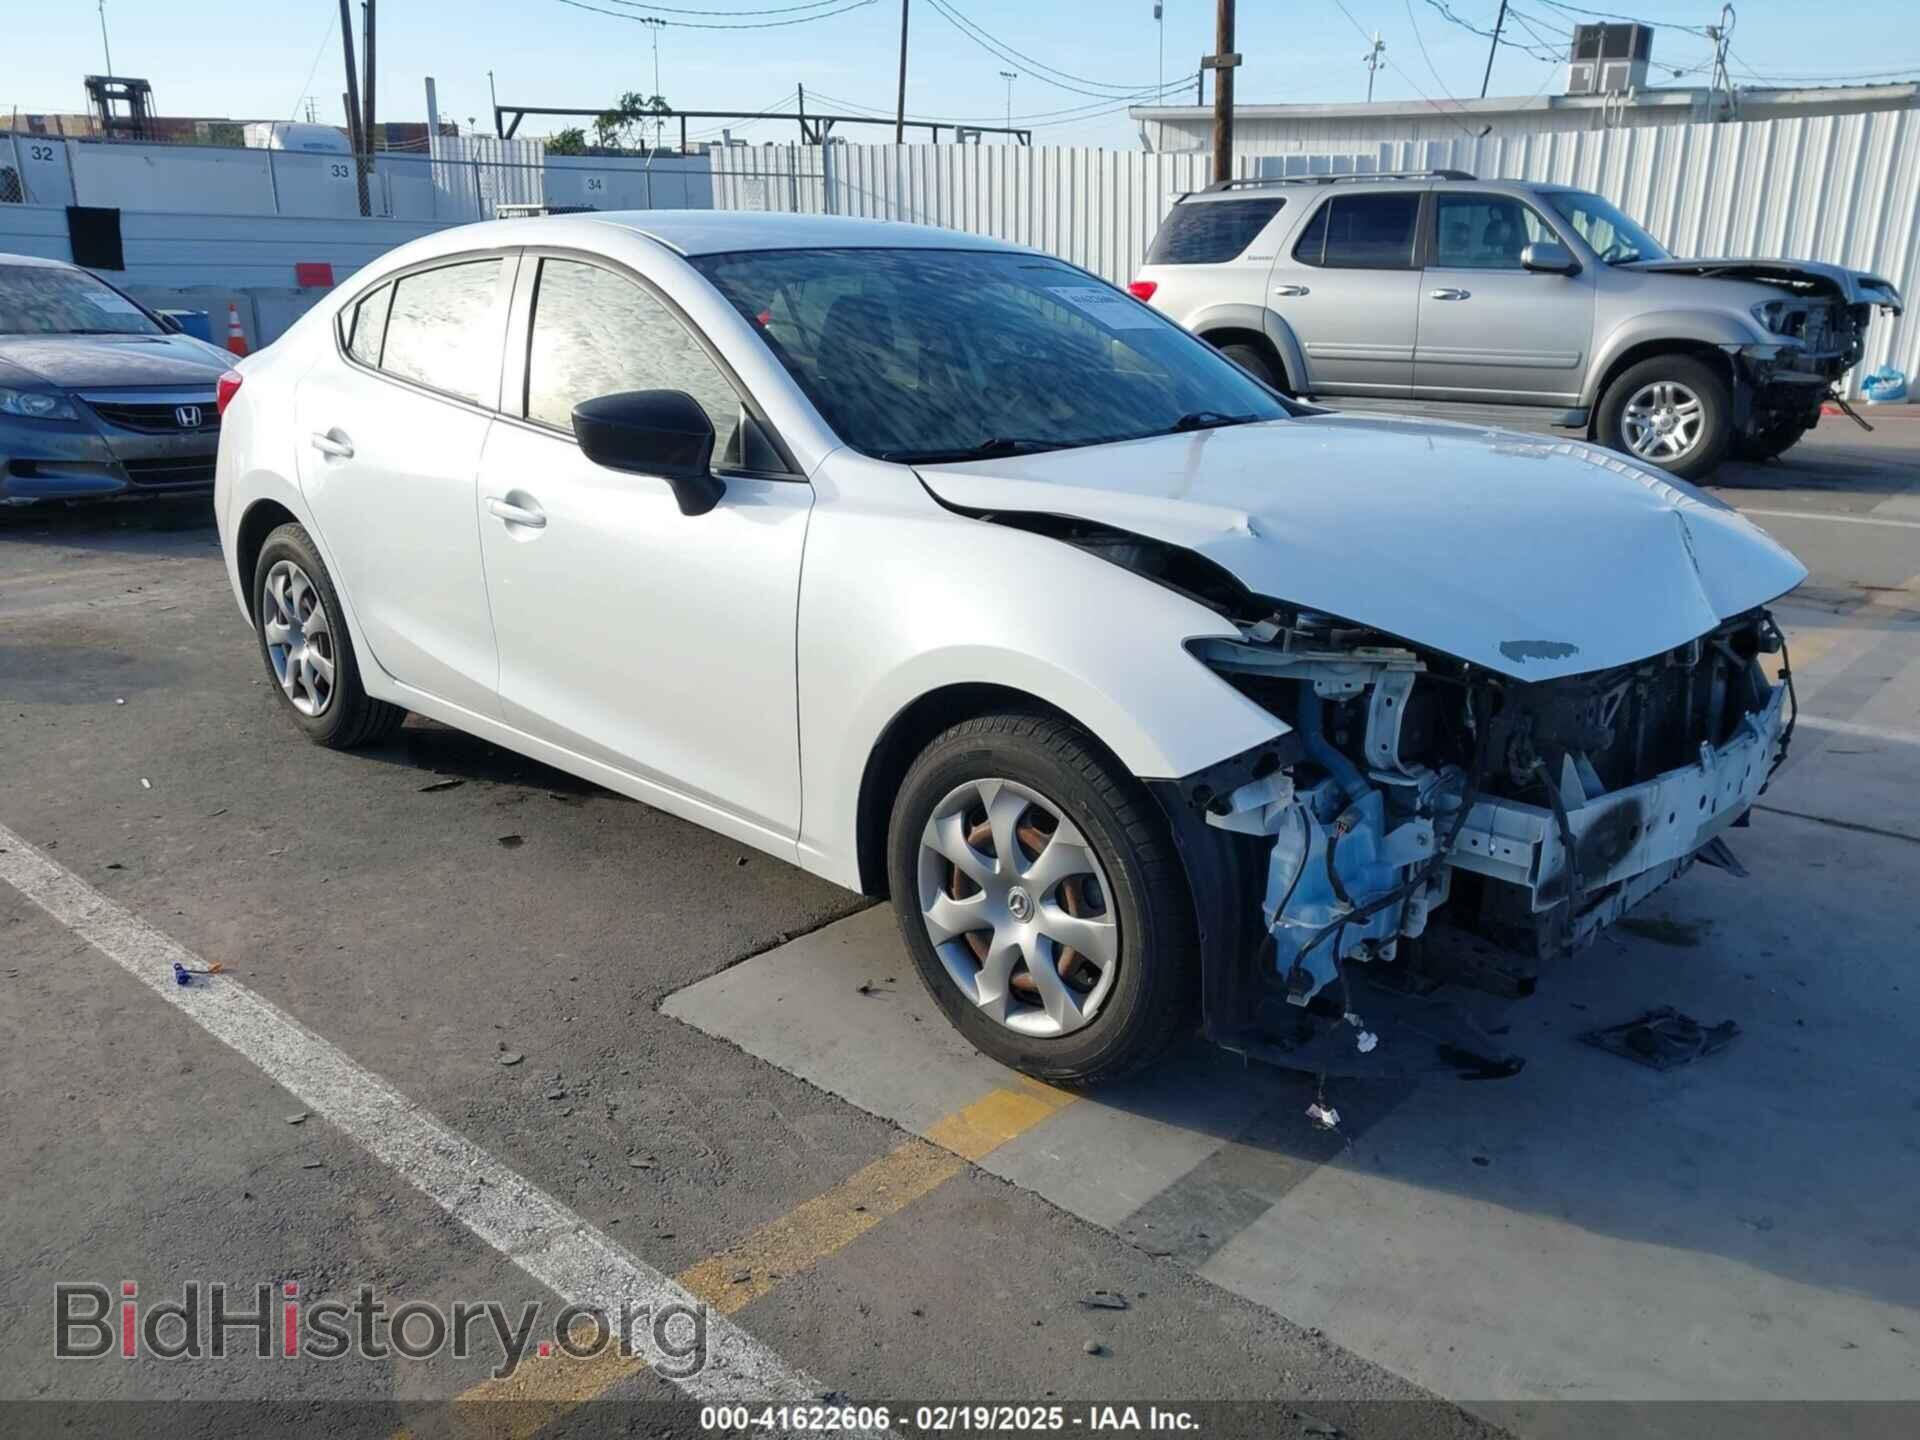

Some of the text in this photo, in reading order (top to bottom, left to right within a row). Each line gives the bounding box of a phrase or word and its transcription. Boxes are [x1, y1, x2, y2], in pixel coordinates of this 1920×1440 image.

[31, 145, 54, 161] 32
[331, 164, 349, 178] 33
[587, 178, 602, 190] 34
